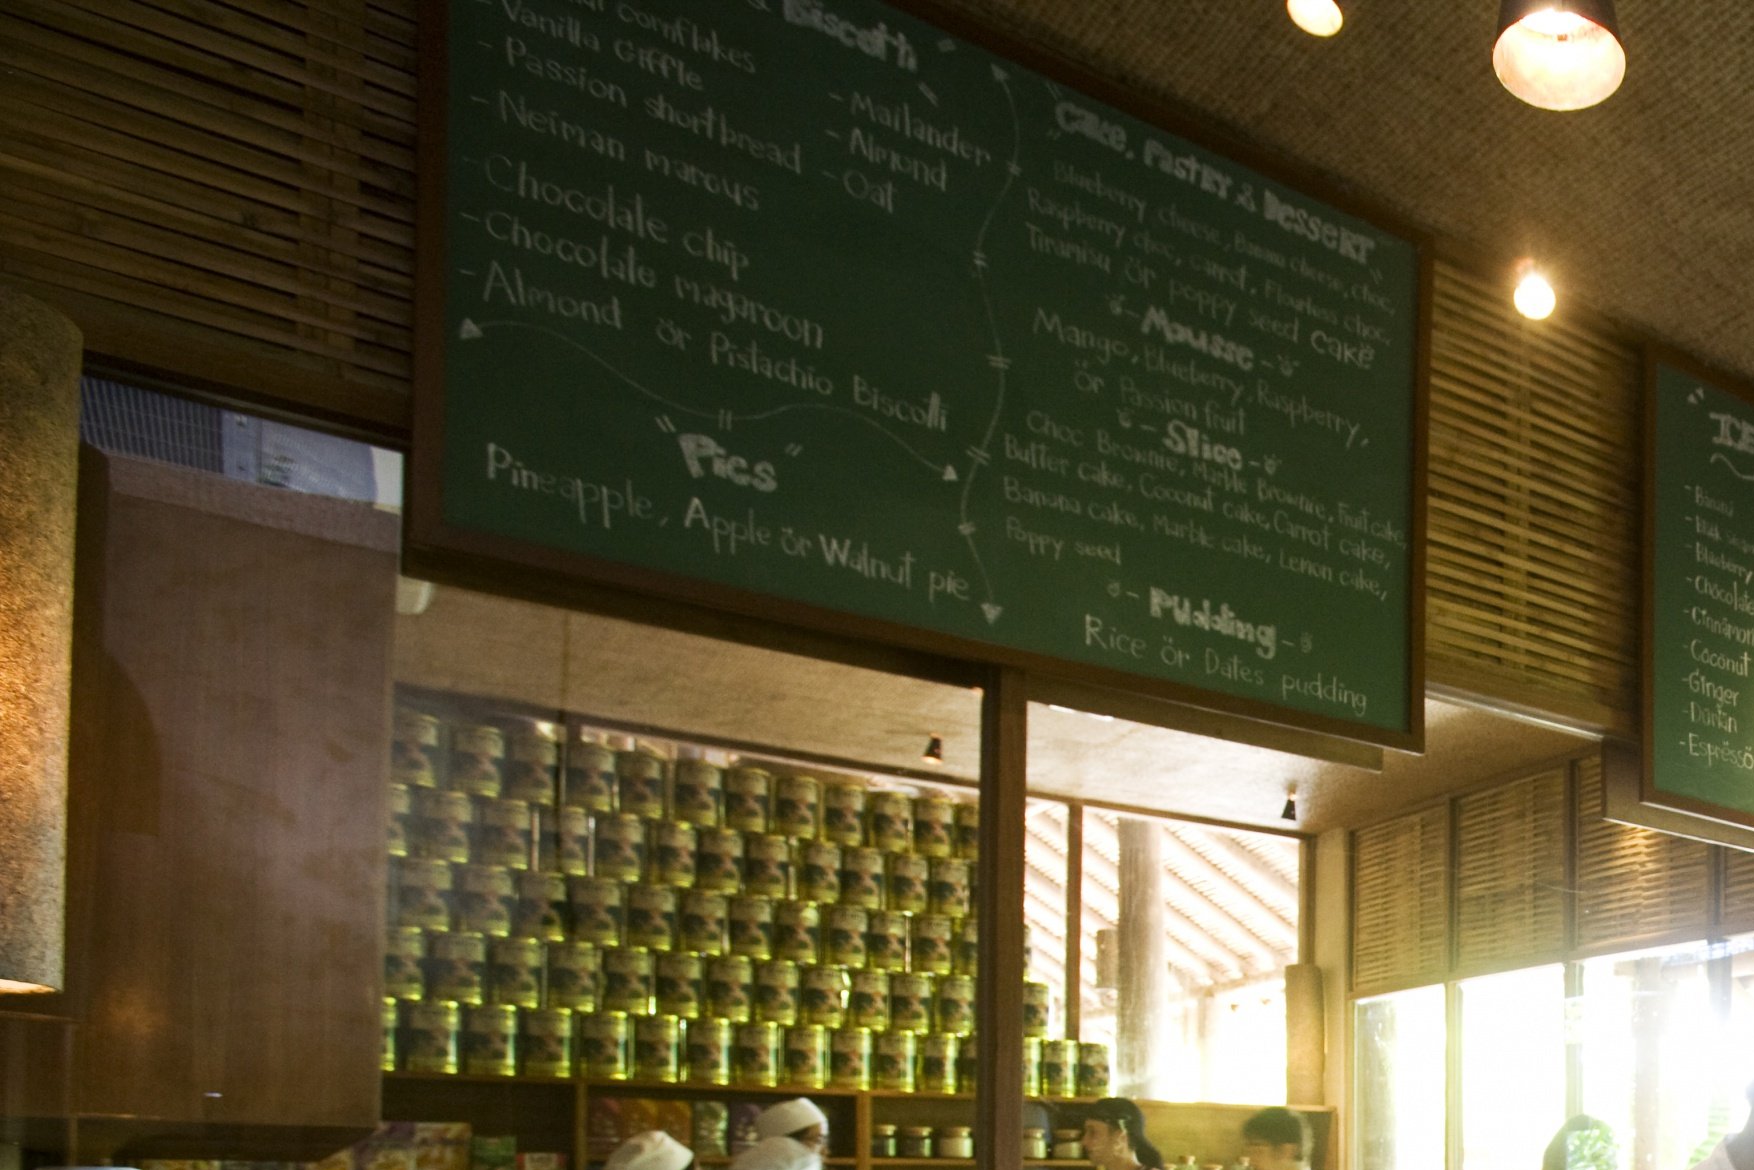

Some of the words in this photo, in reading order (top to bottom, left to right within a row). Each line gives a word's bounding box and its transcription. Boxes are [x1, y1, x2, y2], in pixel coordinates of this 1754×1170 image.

[504, 0, 600, 52] Vanilla
[499, 89, 626, 162] Neiman
[505, 35, 628, 108] Passion
[643, 93, 802, 176] shortbread
[842, 168, 899, 216] Oat
[850, 126, 949, 193] Almond
[484, 153, 669, 245] Chocolate
[682, 226, 751, 283] chip
[484, 209, 658, 290] Chocolate
[482, 259, 625, 332] Almond
[709, 331, 835, 396] Pistachio
[853, 373, 951, 434] Biscotti
[1119, 375, 1198, 422] Passion
[1203, 400, 1246, 436] fruit
[1004, 433, 1070, 477] Butter
[1003, 475, 1083, 515] Banana
[683, 496, 773, 556] Apple
[819, 532, 917, 590] Walnut
[927, 566, 973, 610] pie
[1006, 515, 1065, 562] Poppy
[1074, 540, 1123, 567] seed
[1148, 585, 1278, 661] Pudding
[1084, 612, 1148, 660] Rice
[1205, 647, 1266, 686] Dates
[1281, 673, 1368, 717] pudding
